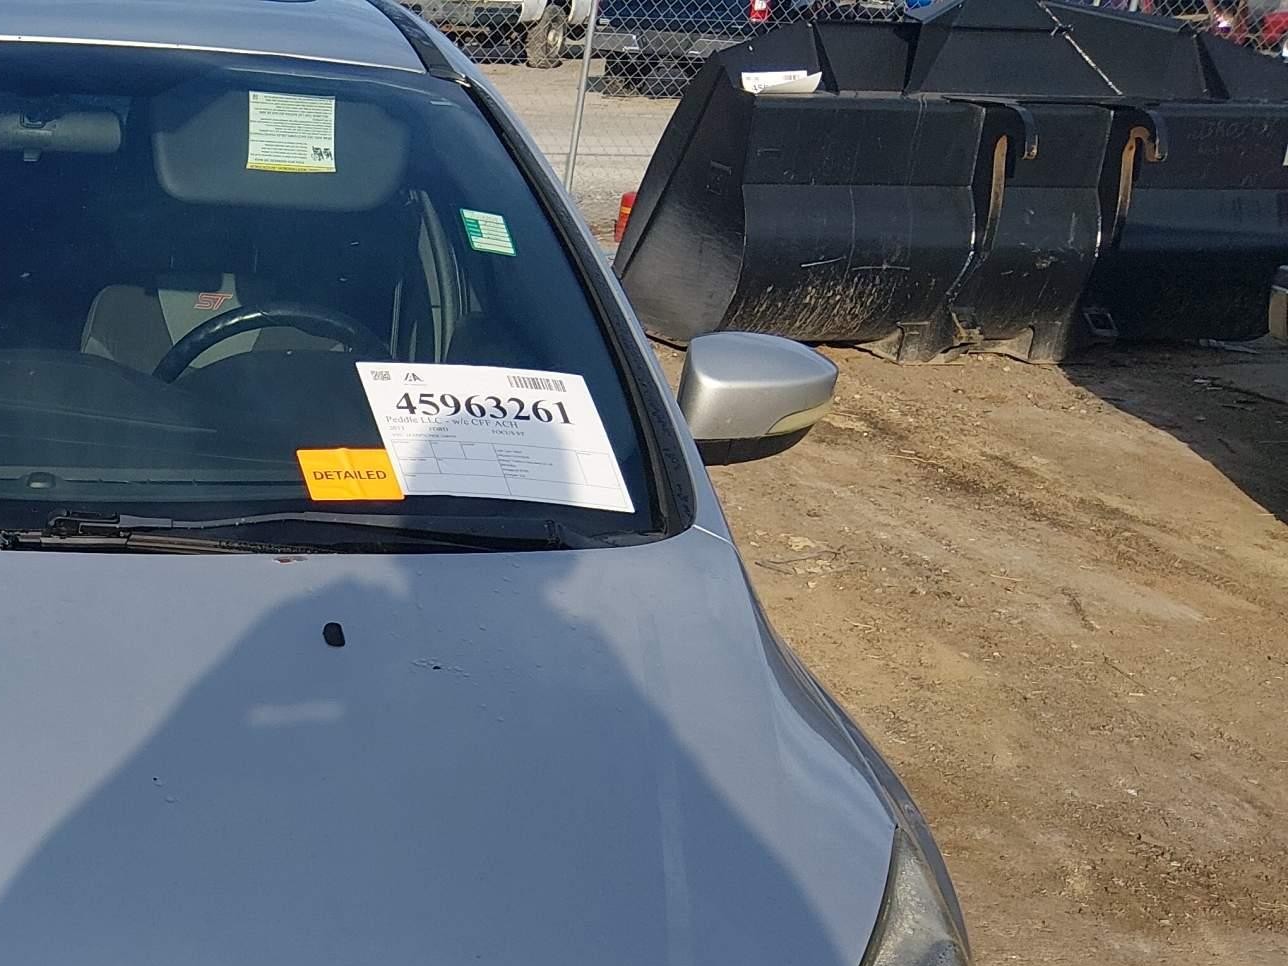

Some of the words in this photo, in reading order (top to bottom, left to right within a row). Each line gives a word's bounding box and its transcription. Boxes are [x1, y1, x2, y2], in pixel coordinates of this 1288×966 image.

[193, 293, 233, 311] ST
[396, 392, 576, 425] 45963261
[495, 419, 519, 429] ACH
[312, 470, 388, 481] DETAILED
